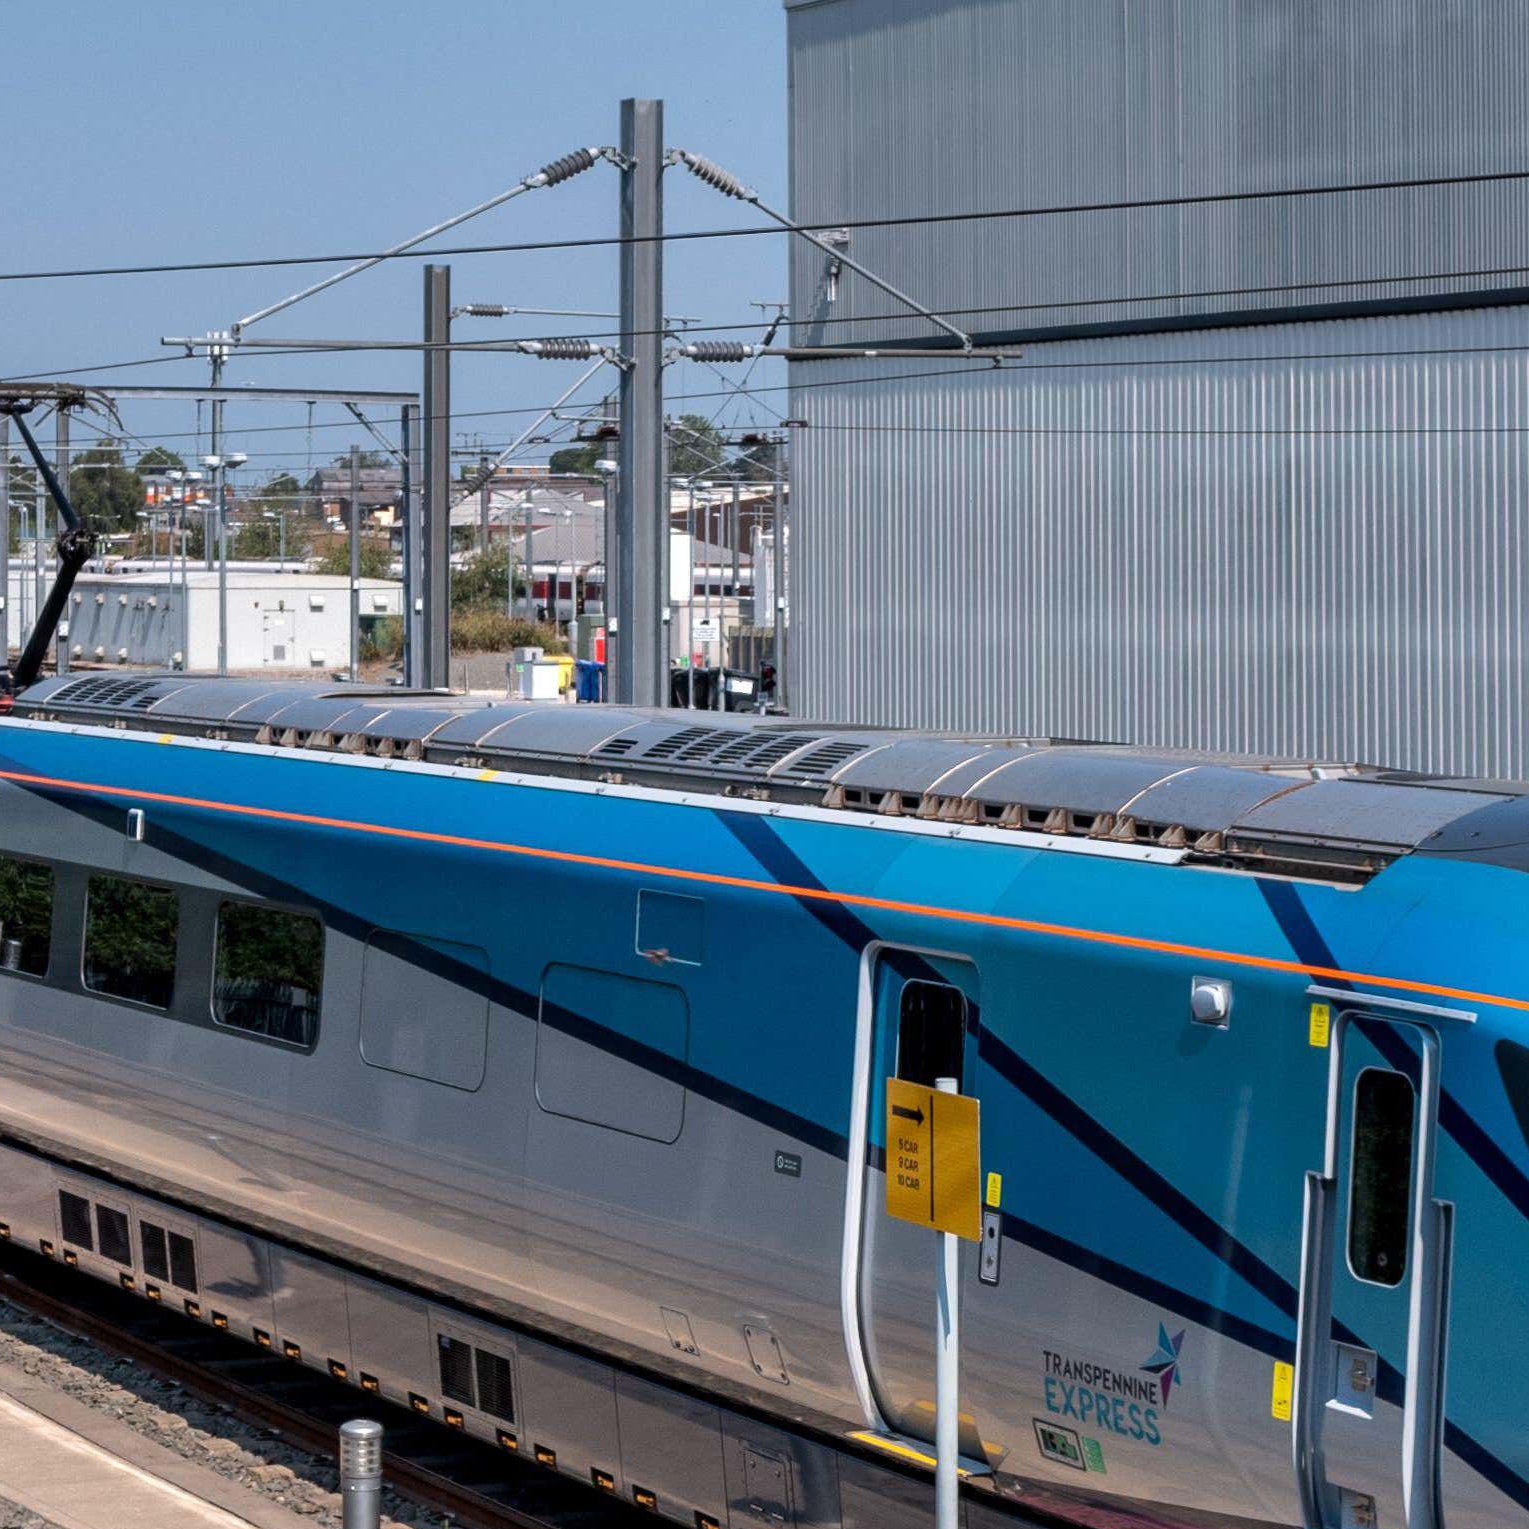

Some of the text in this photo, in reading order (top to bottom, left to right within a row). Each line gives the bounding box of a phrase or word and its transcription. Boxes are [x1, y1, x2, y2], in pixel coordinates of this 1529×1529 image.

[904, 1140, 918, 1154] CAR
[904, 1158, 919, 1172] CAR
[897, 1174, 920, 1191] 10 CAR
[1043, 1350, 1158, 1405] TRANSPENNINE
[1044, 1375, 1162, 1446] EXPRESS
